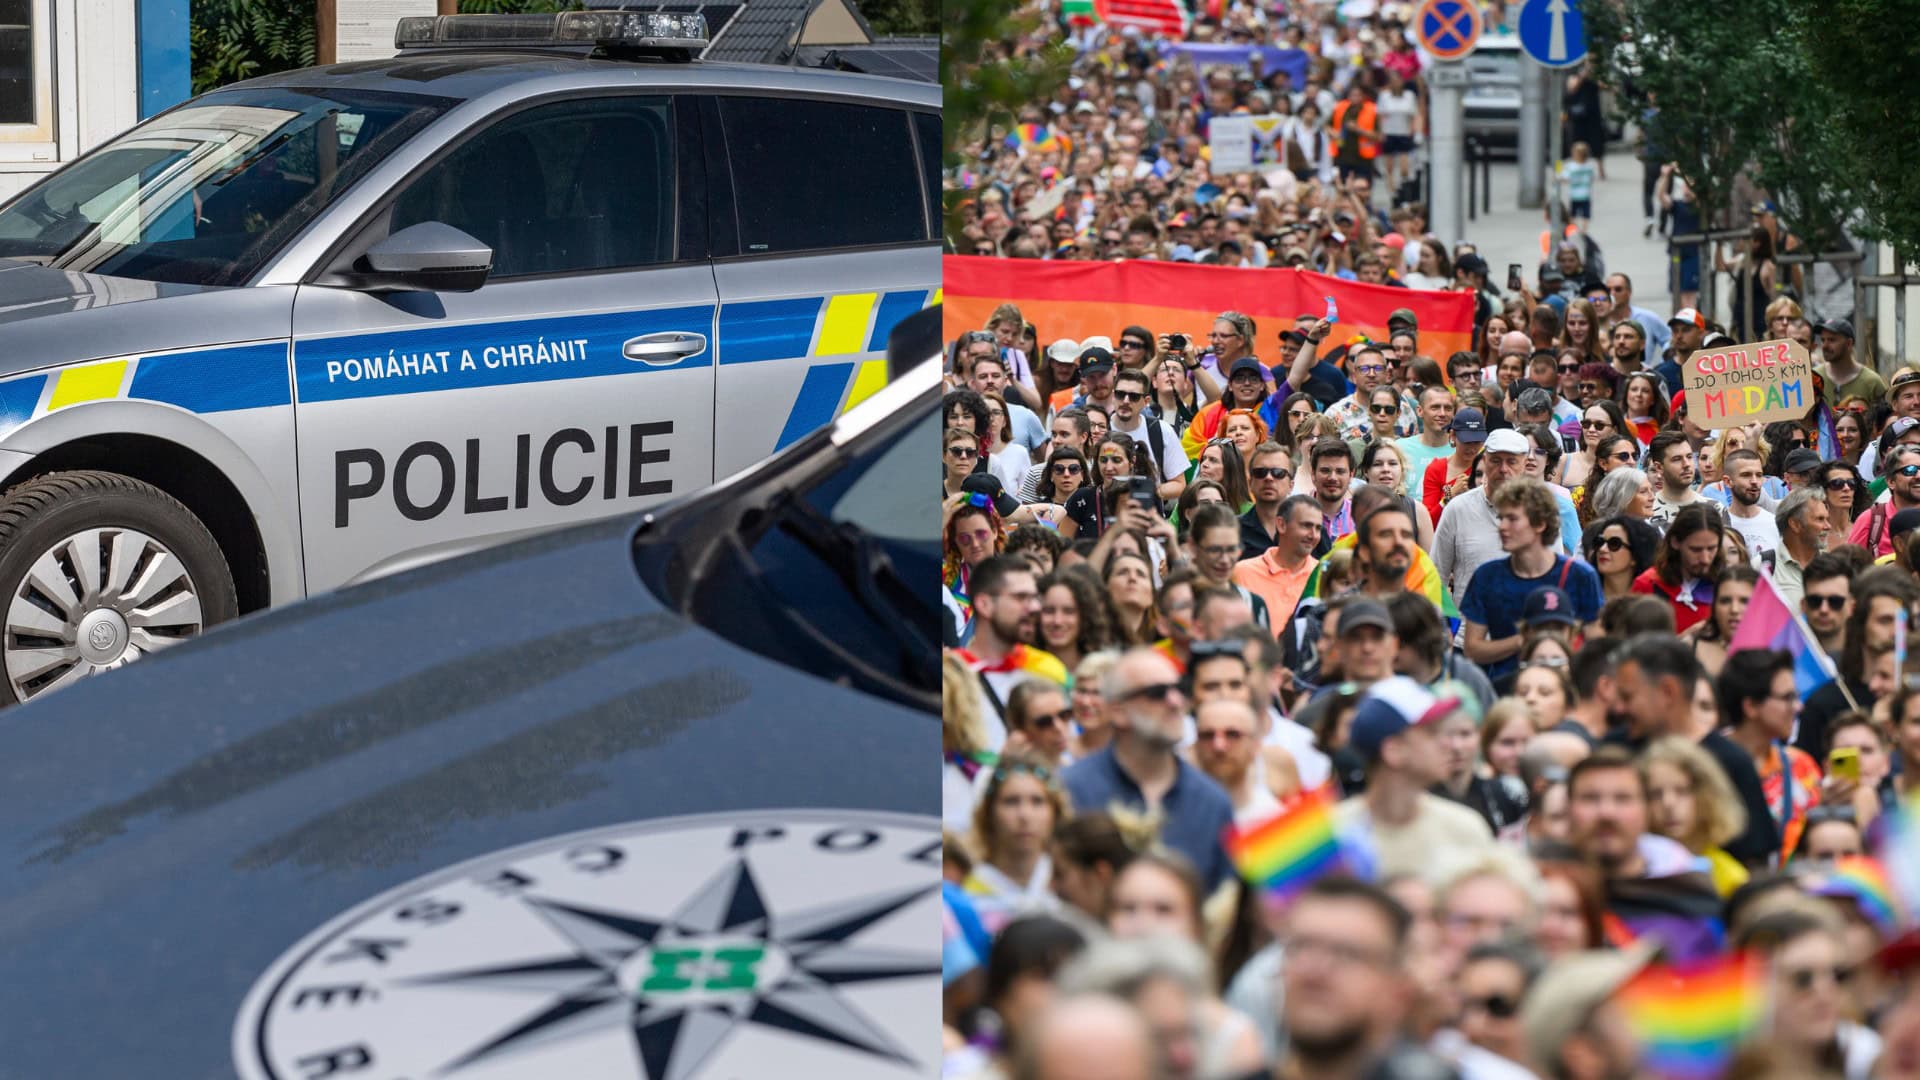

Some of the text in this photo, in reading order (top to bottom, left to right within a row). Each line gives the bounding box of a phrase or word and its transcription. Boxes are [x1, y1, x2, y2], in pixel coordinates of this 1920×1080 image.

[326, 337, 588, 383] POMÁHAT A CHRÁNIT
[335, 421, 674, 529] POLICIE
